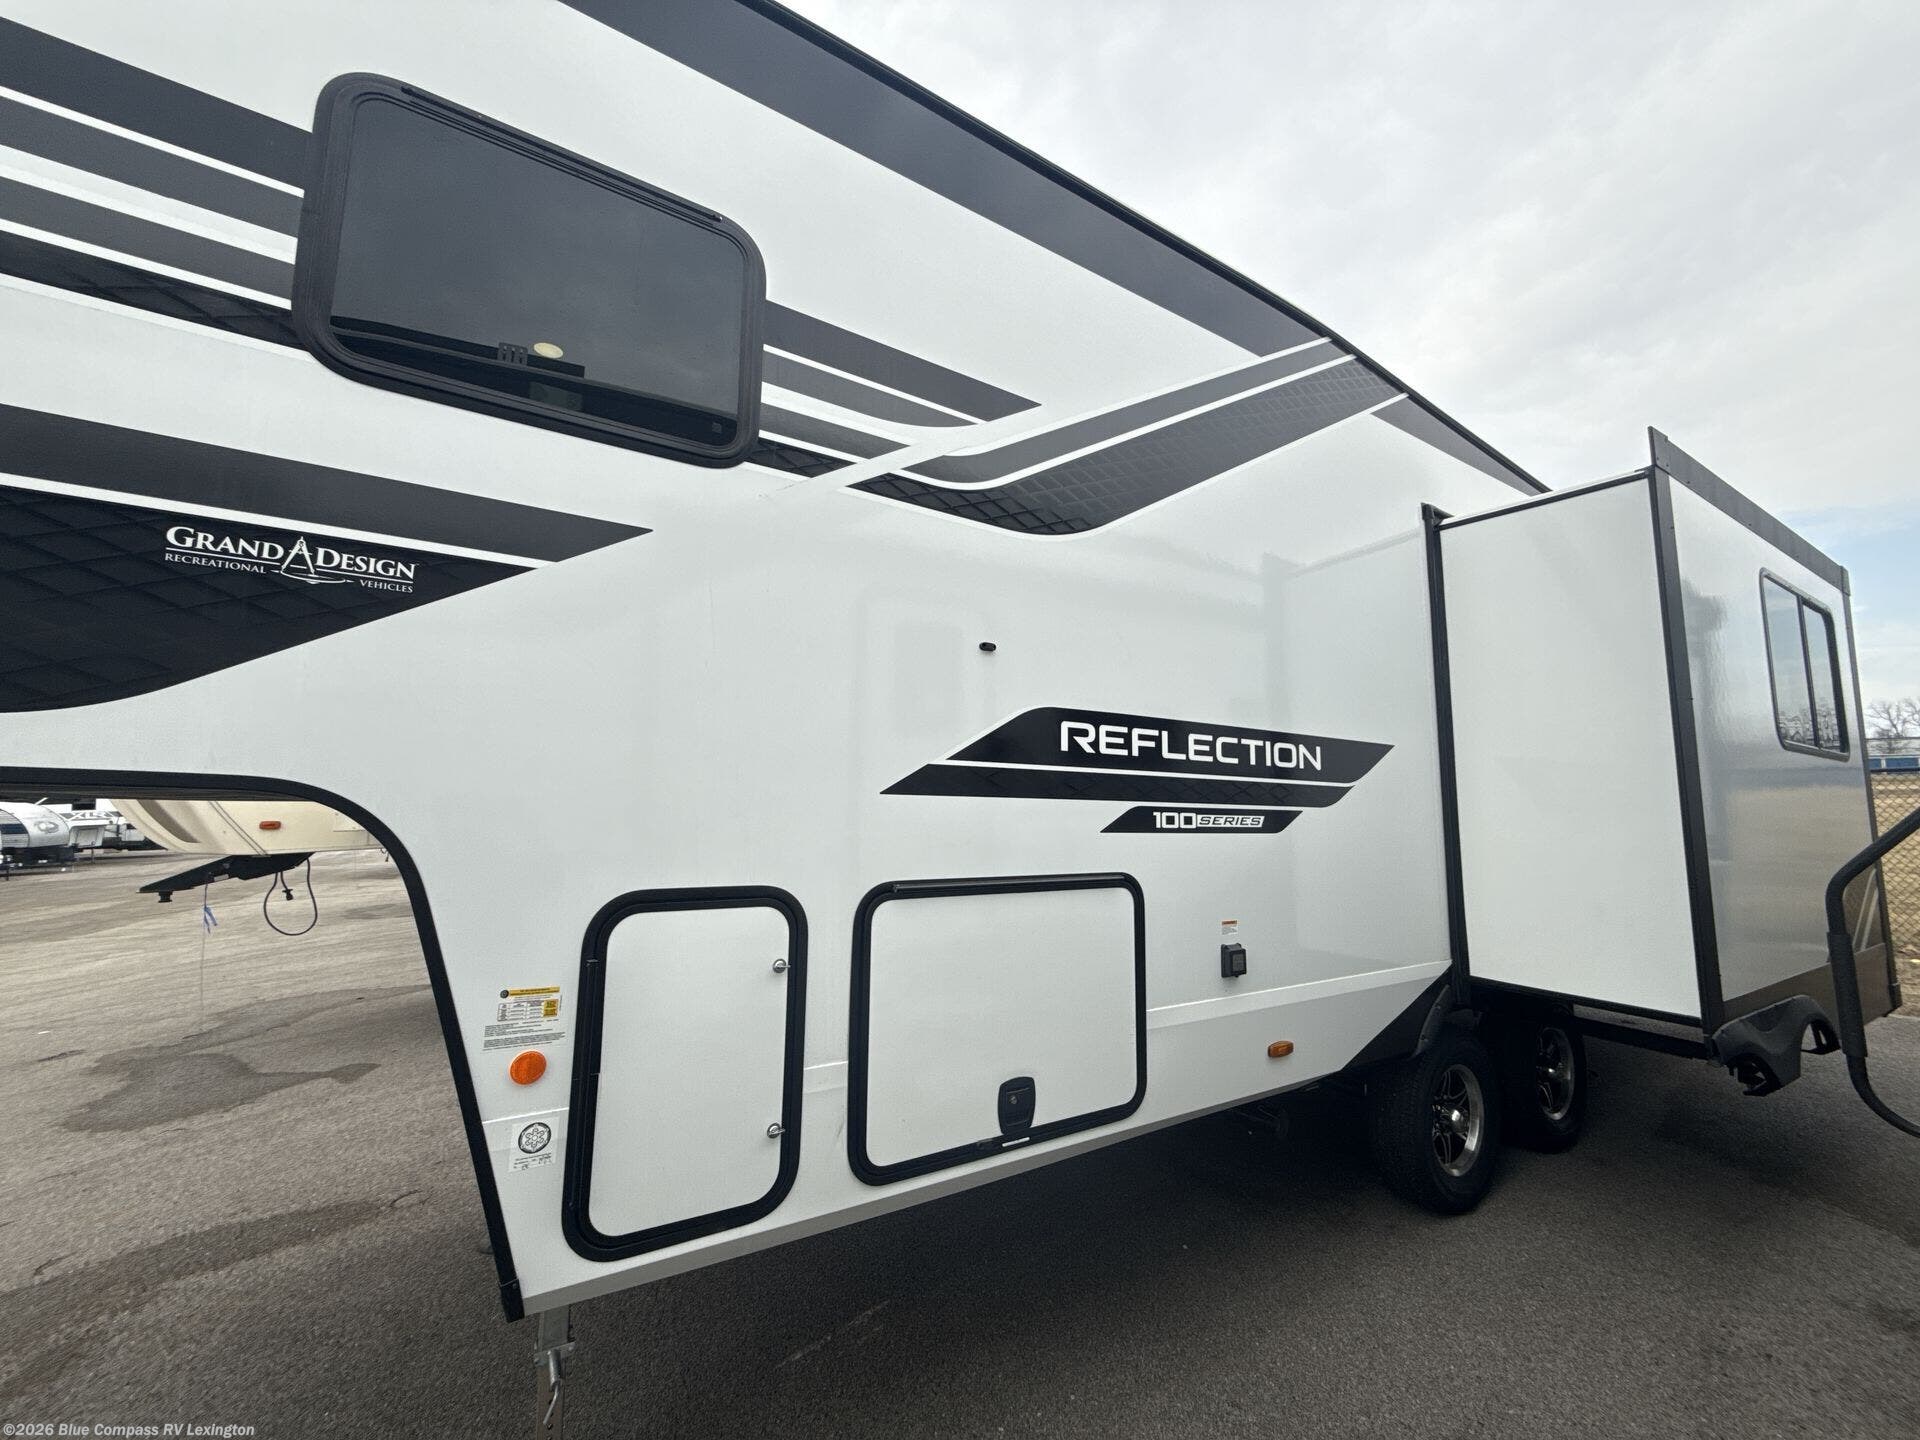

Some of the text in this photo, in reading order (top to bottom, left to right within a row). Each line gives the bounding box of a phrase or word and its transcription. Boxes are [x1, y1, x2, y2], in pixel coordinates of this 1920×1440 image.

[164, 552, 414, 593] RECREATIONAL VEHICLES
[165, 526, 416, 579] GRAND DESIGN
[1059, 720, 1322, 771] REFLECTION
[1153, 811, 1263, 829] 100 SERIES
